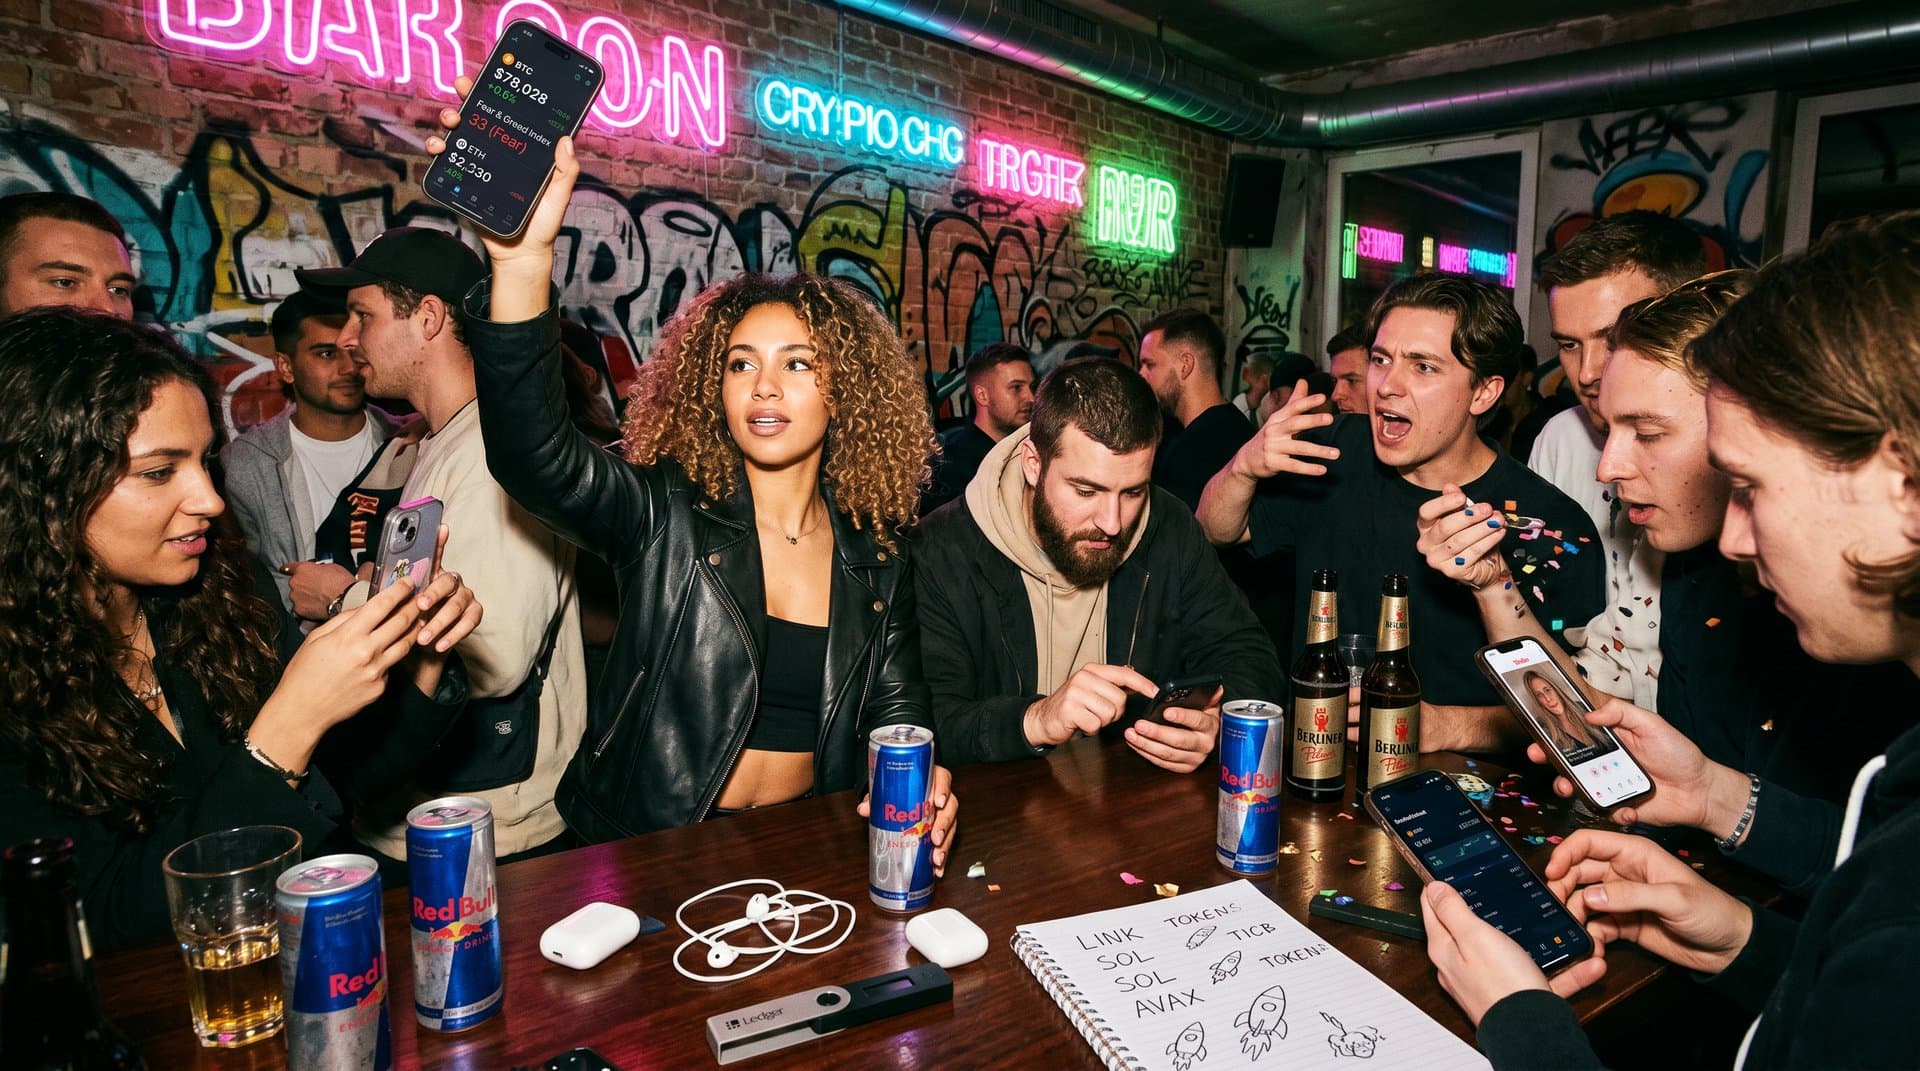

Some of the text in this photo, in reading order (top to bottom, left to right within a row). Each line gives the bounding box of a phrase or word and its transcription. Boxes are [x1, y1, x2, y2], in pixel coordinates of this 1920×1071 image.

[515, 60, 534, 76] BTC
[487, 83, 518, 104] +0.6%
[493, 67, 548, 105] $78,028
[469, 113, 487, 130] 33
[488, 125, 527, 154] (Fear)
[477, 99, 496, 115] Fear
[494, 110, 503, 120] &
[503, 114, 530, 134] Greed
[529, 129, 552, 147] Index
[467, 144, 487, 160] ETH
[1297, 728, 1344, 746] BERLINER
[1221, 765, 1251, 789] Red
[884, 802, 921, 822] Red
[413, 884, 496, 921] Red Bull
[1163, 902, 1243, 928] TOKENS
[1076, 927, 1144, 951] LINK
[1097, 950, 1155, 971] SOL
[329, 957, 379, 999] Red
[1114, 970, 1177, 993] SOL
[742, 1006, 785, 1025] Ledger
[1135, 988, 1205, 1019] AVAX
